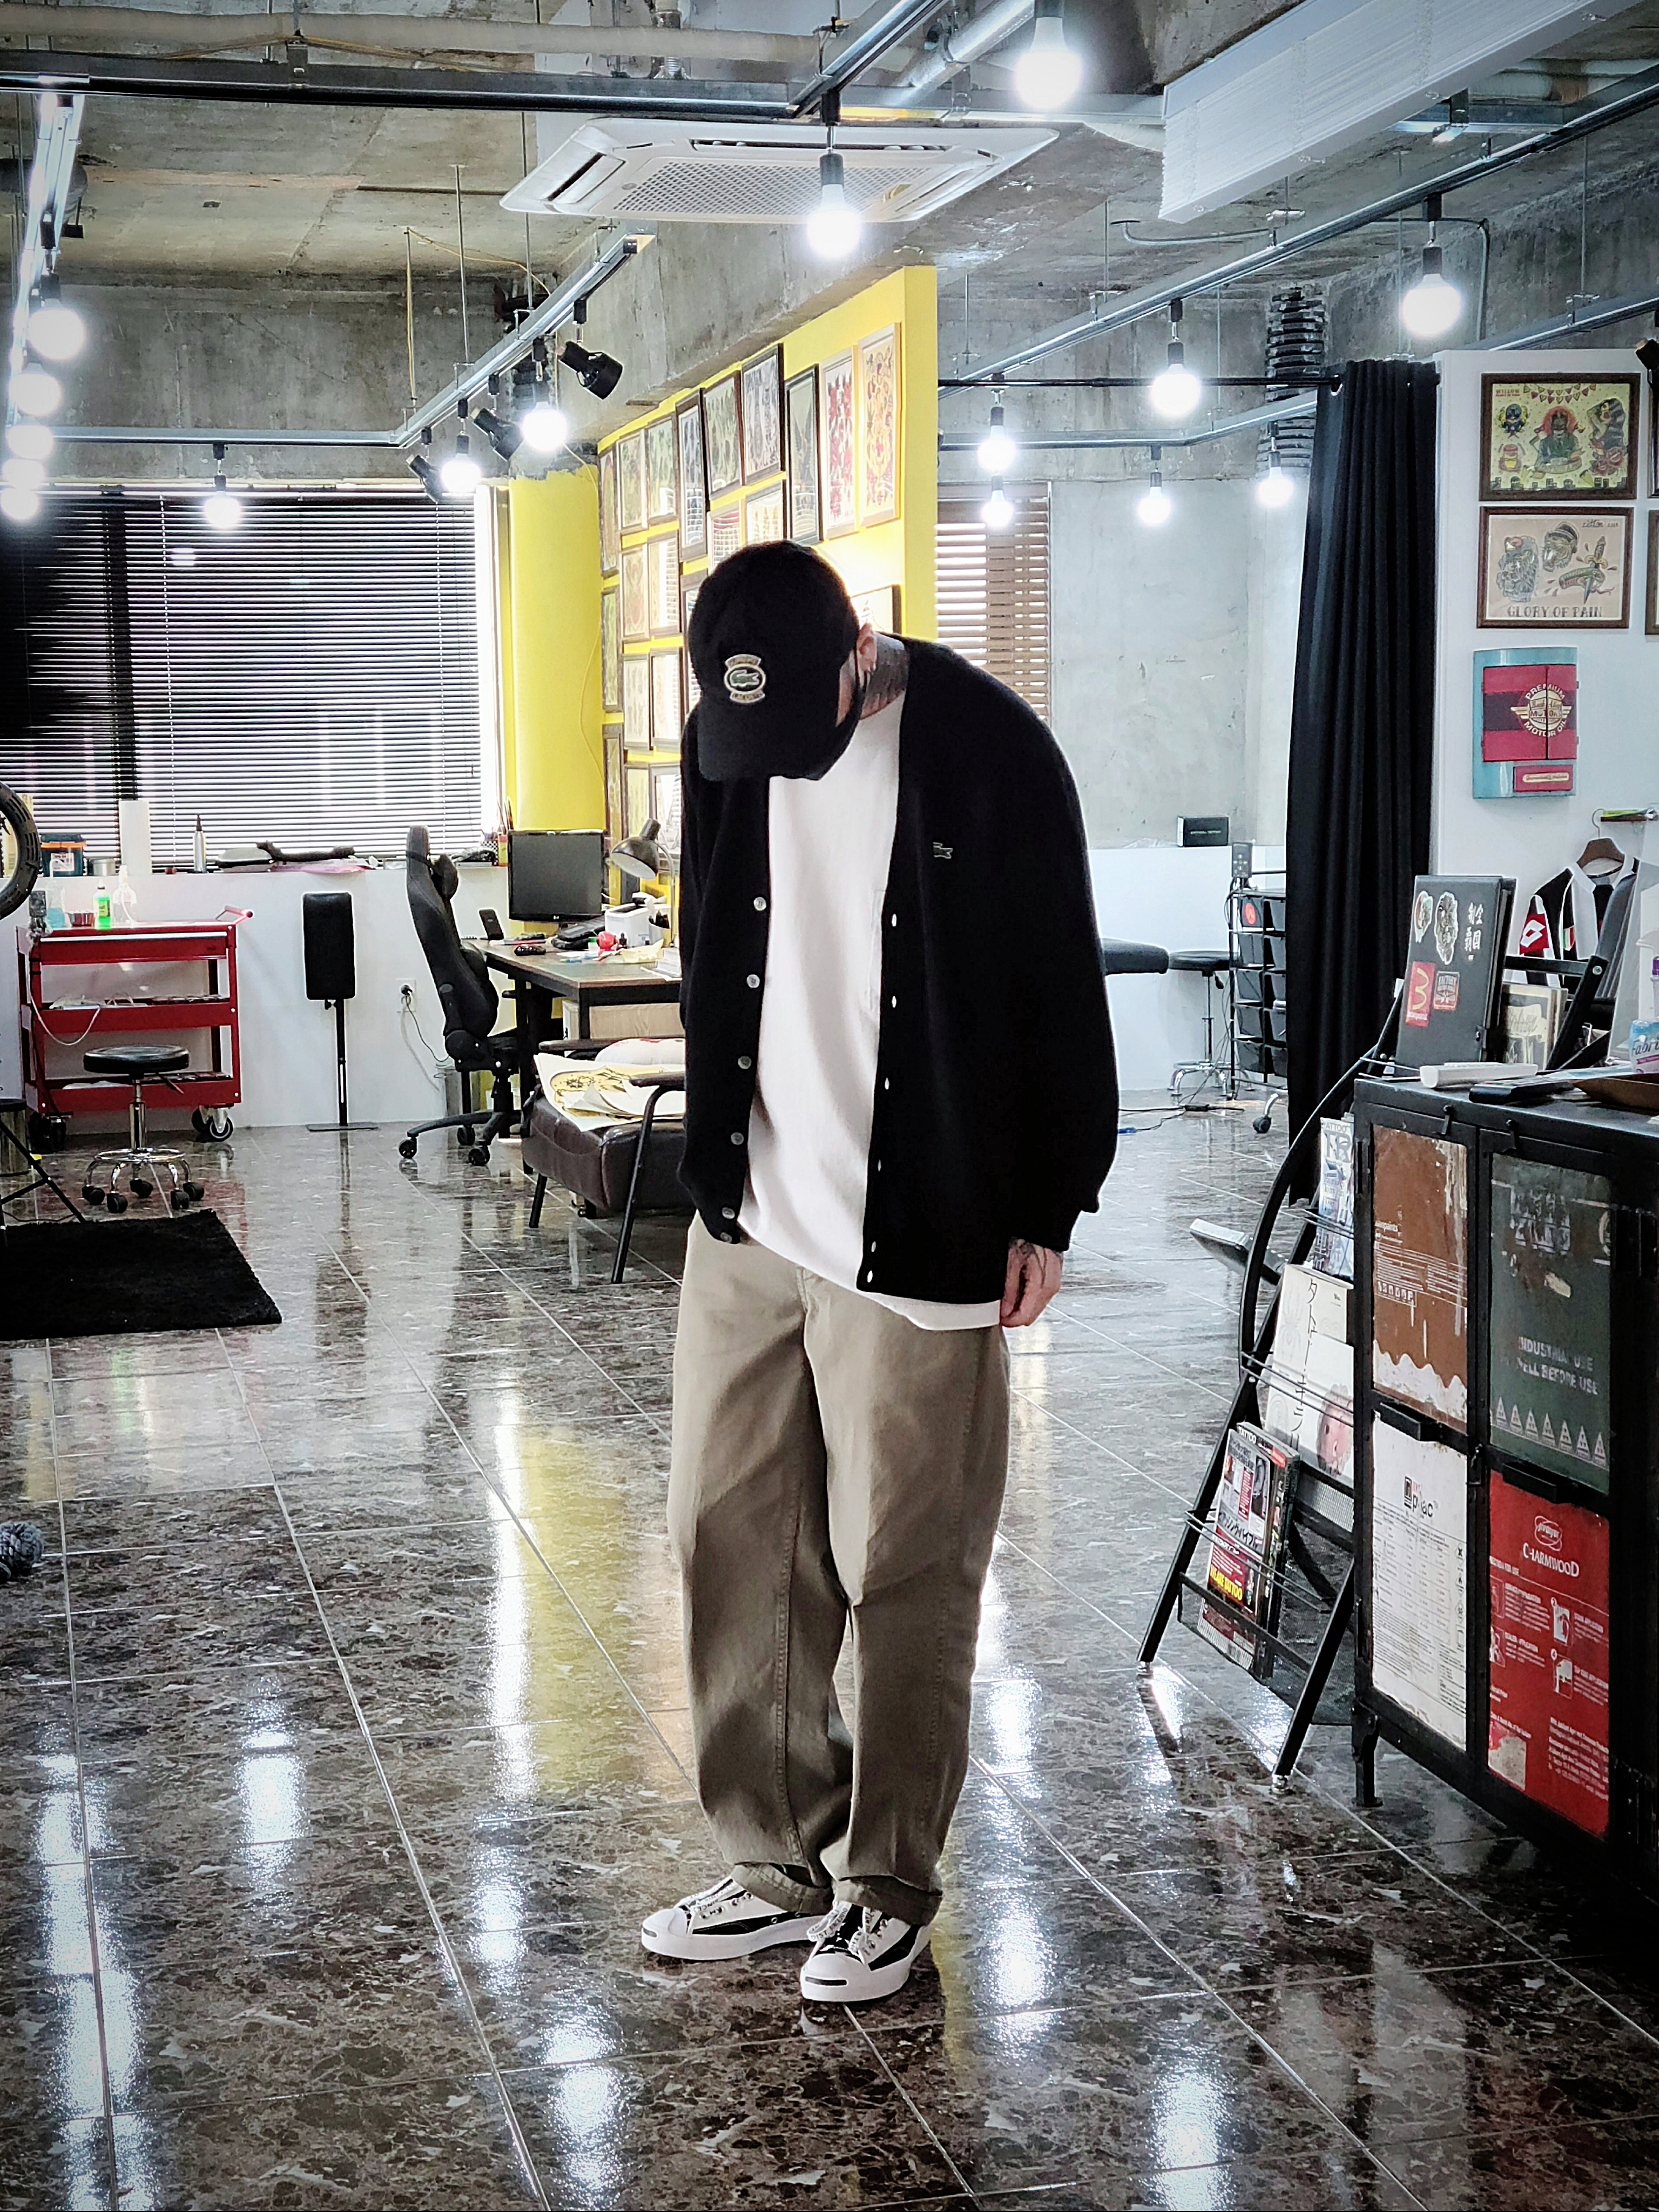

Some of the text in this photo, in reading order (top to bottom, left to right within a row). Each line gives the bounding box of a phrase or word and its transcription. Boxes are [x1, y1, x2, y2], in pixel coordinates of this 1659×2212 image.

[1507, 605, 1603, 618] GLORY OF PAIN
[1525, 683, 1566, 700] PREMIUM
[1523, 720, 1567, 738] MOTOR OIL
[1238, 1426, 1257, 1444] TATTOO
[1523, 1542, 1580, 1577] CHARMWOOD
[1224, 1577, 1243, 1601] TATTOO
